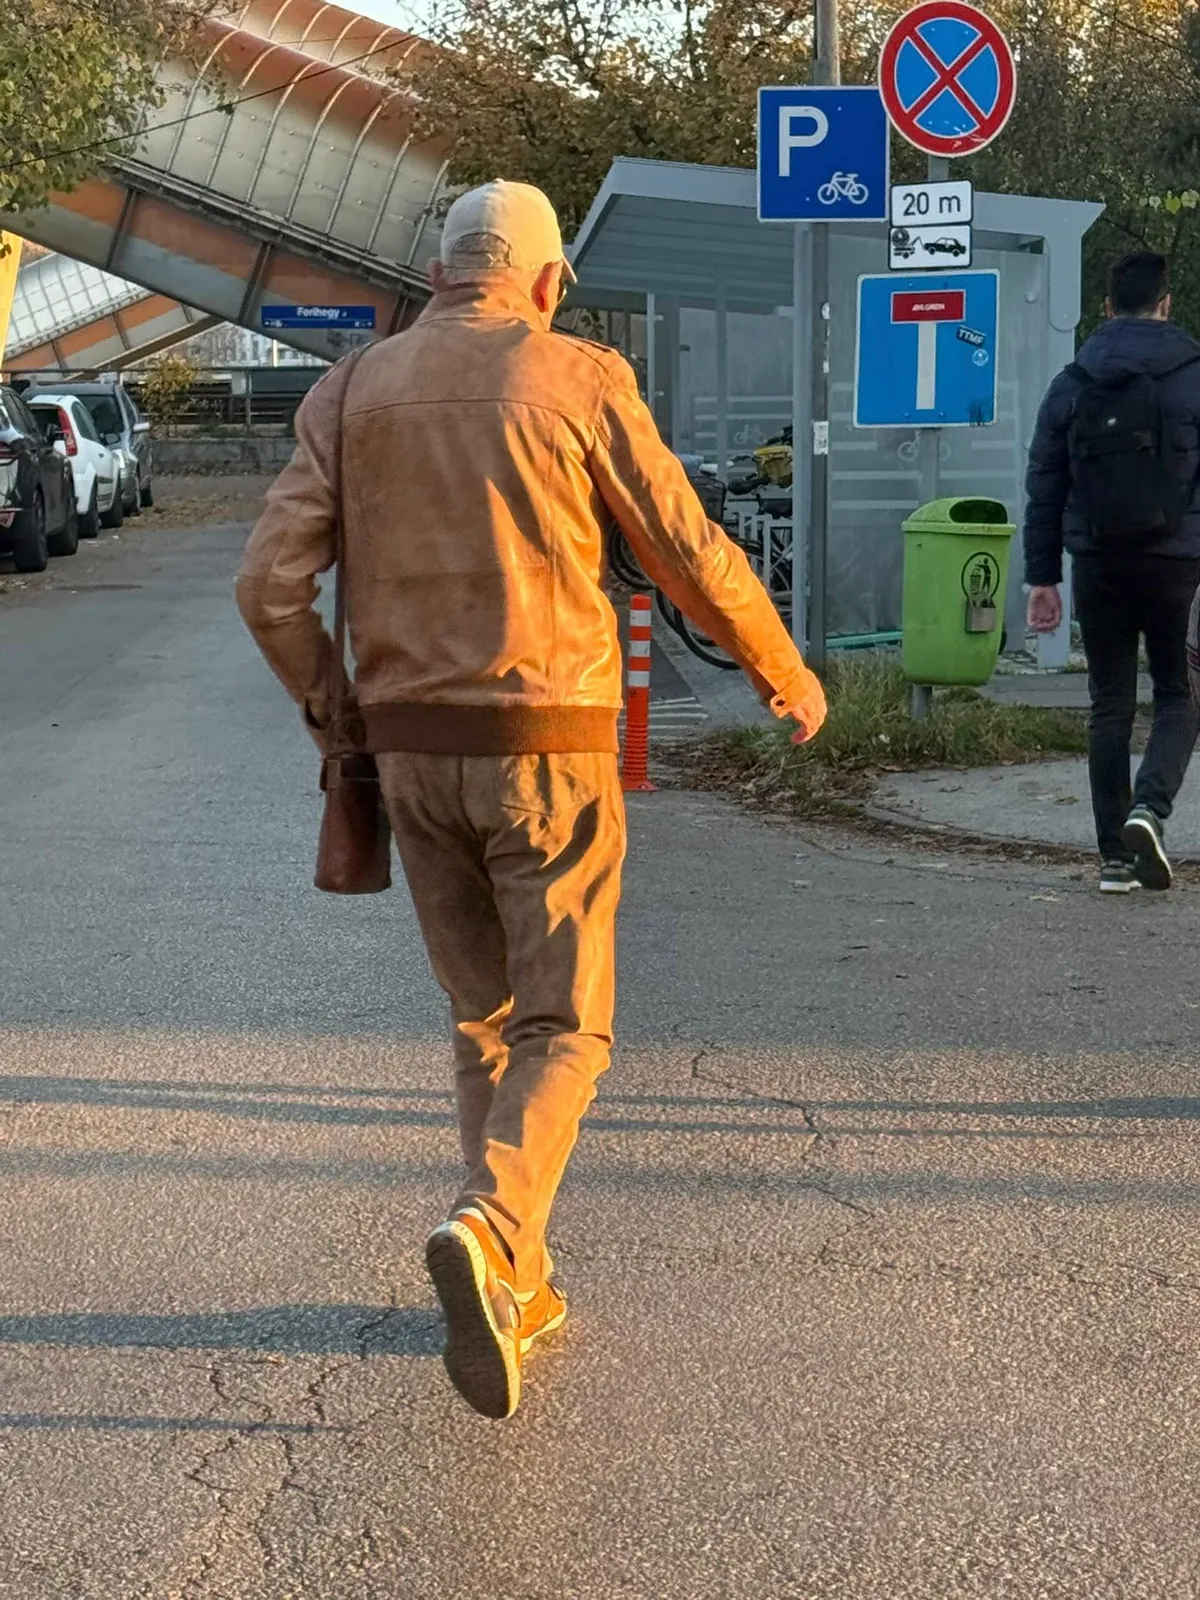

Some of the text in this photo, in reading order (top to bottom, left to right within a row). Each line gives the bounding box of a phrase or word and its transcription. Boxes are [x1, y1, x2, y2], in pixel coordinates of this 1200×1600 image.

[778, 105, 829, 177] P
[902, 191, 961, 216] 20 m
